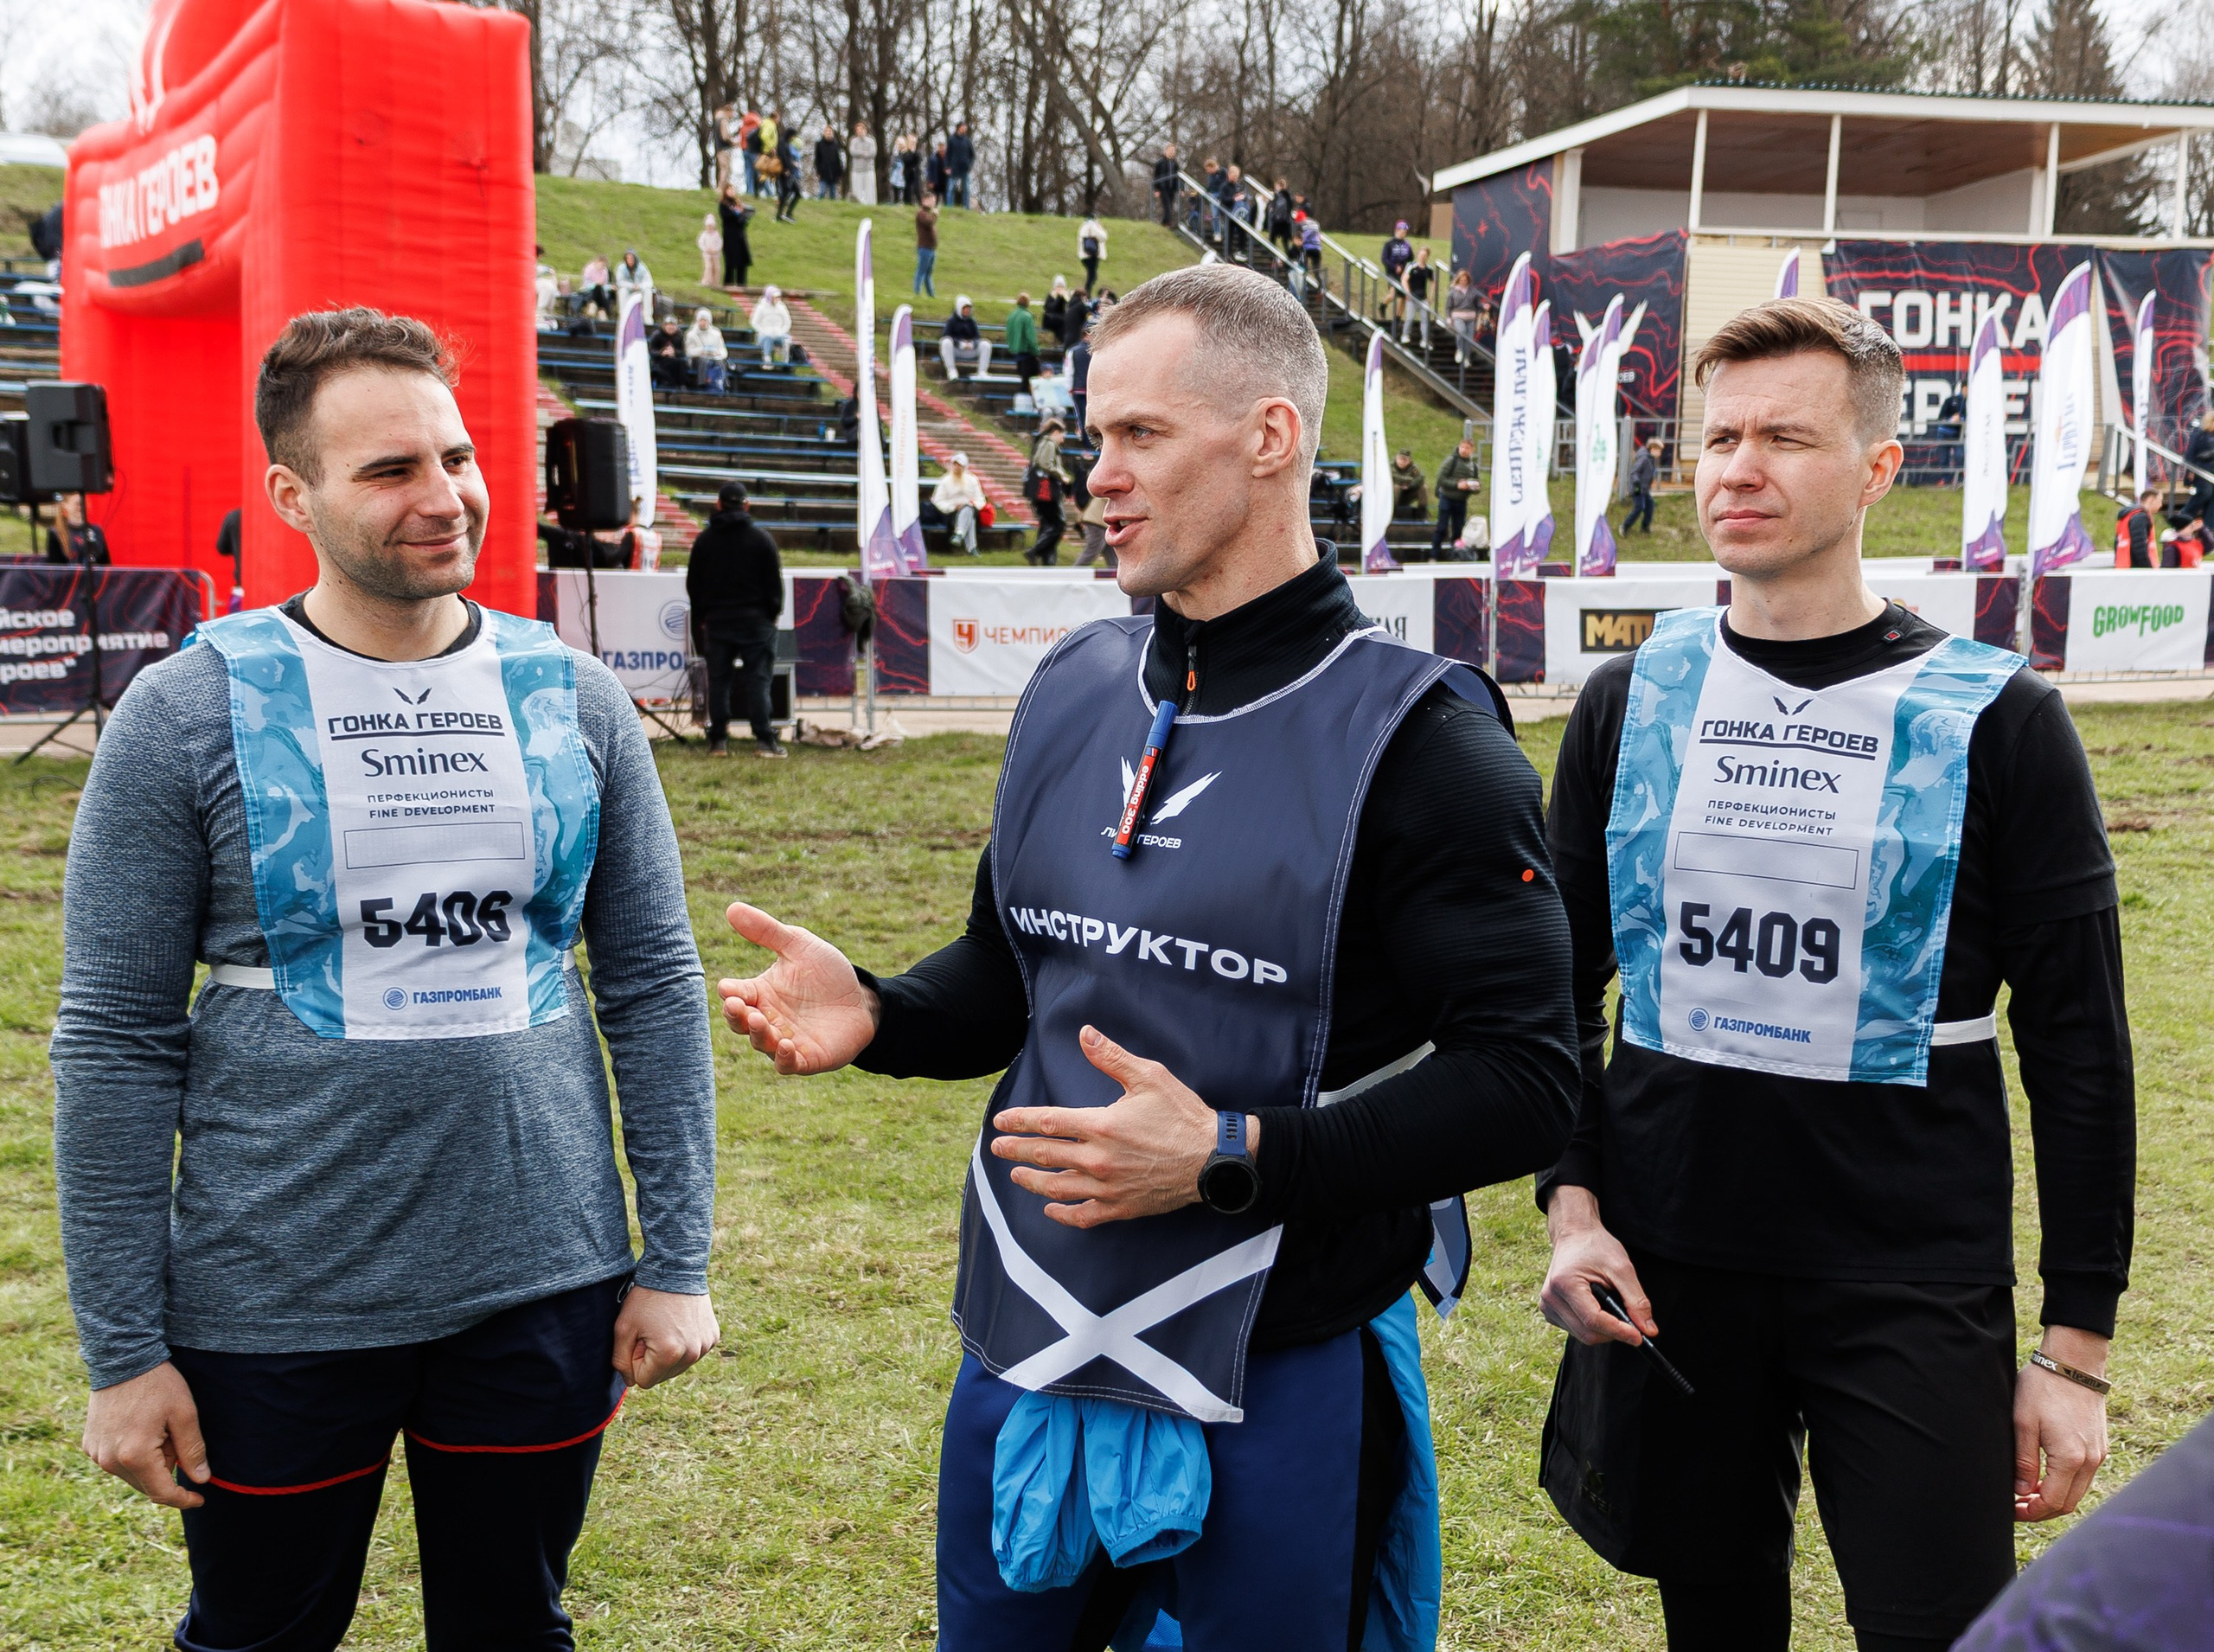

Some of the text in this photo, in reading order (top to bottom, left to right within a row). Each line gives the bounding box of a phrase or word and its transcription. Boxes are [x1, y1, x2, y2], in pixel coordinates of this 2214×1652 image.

[1859, 289, 2047, 349] ГОНКА
[2093, 605, 2185, 638] GROWFOOD
[602, 650, 689, 671] ГАЗПРО
[327, 712, 503, 733] ГОНКА ГЕРОЕВ
[1700, 720, 1878, 753] ГОНКА ГЕРОЕВ
[361, 746, 490, 777] Sminex
[1714, 755, 1842, 794] Sminex
[368, 789, 494, 804] ПЕРФЕКЦИОНИСТЫ
[1121, 765, 1149, 835] edding 300
[1707, 799, 1836, 821] ПЕРФЕКЦИОНИСТЫ
[369, 804, 496, 819] FINE DEVELOPMENT
[1705, 815, 1833, 836] FINE DEVELOPMENT
[1136, 834, 1182, 849] ГЕРОЕВ
[360, 890, 515, 948] 5406
[1009, 906, 1288, 984] ИНСТРУКТОР
[1679, 901, 1840, 984] 5409
[413, 986, 503, 1004] ГАЗПРОМБАНК
[1713, 1016, 1812, 1044] ГАЗПРОМБАНК
[2071, 1369, 2096, 1388] team
